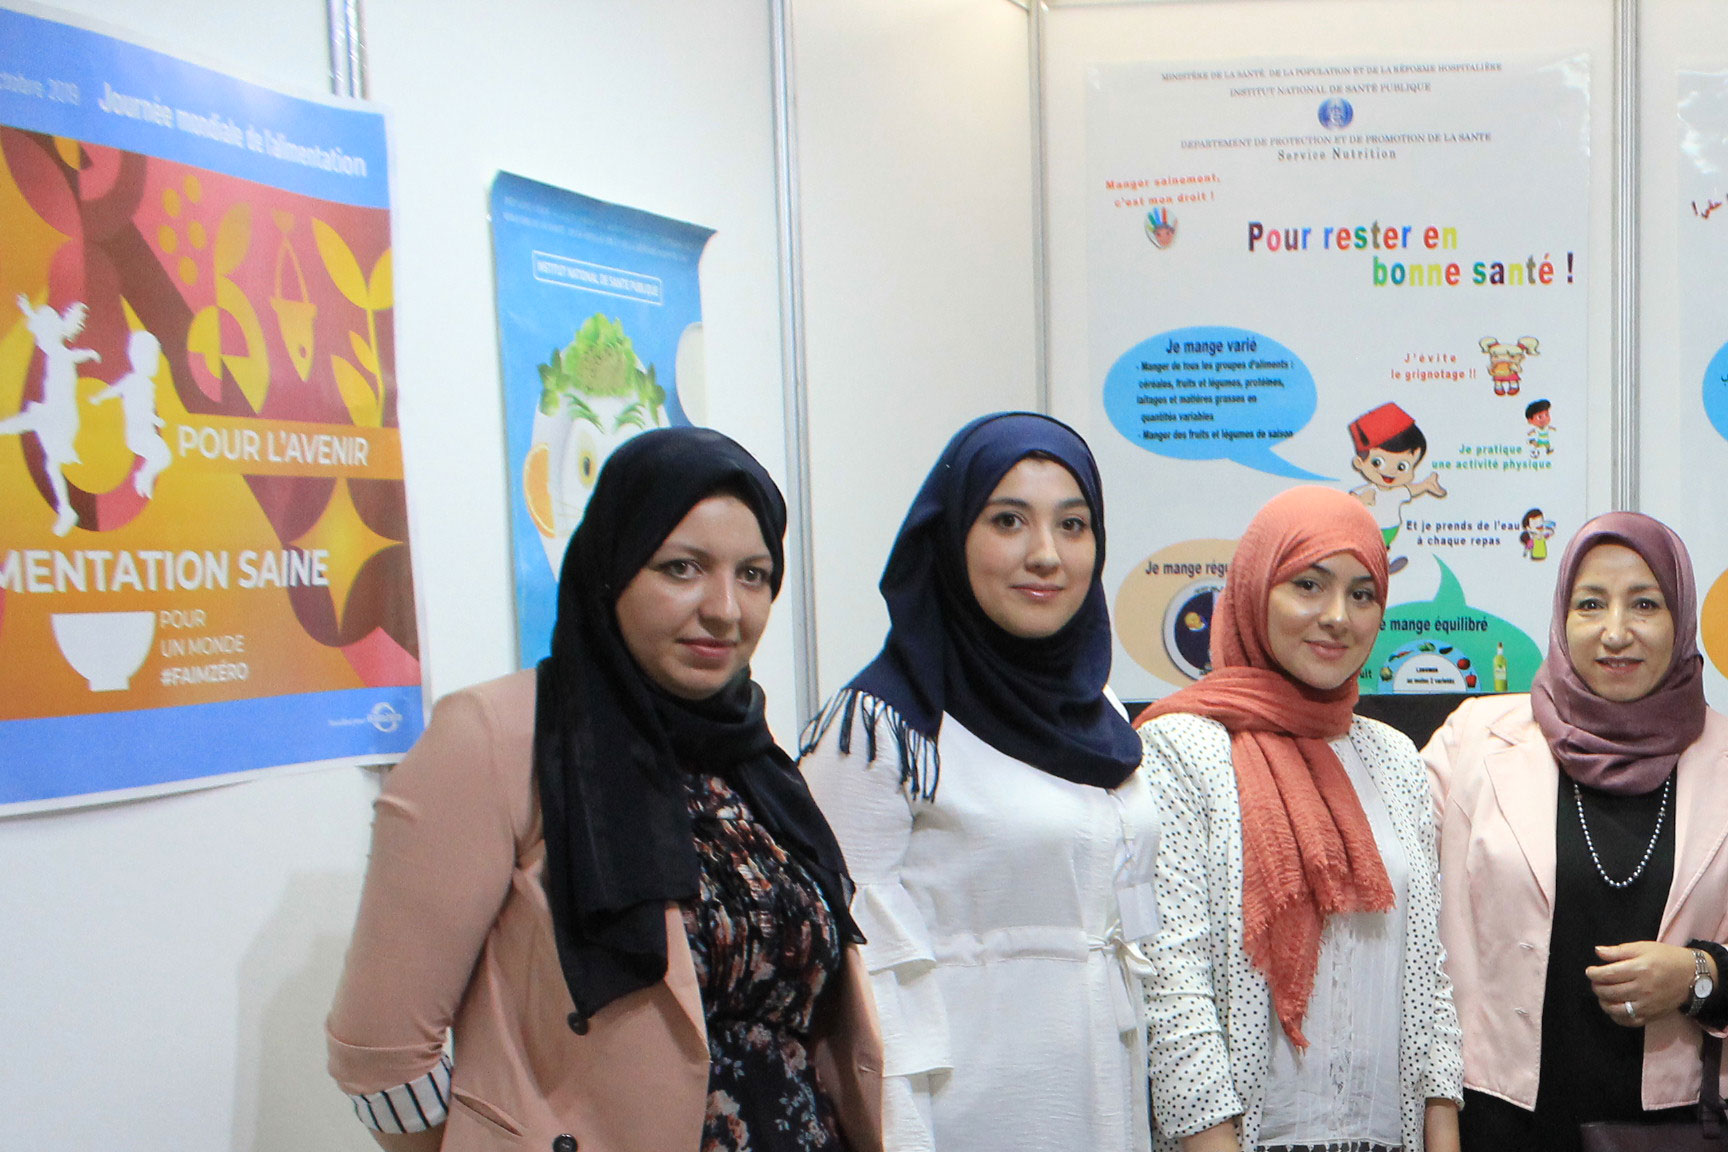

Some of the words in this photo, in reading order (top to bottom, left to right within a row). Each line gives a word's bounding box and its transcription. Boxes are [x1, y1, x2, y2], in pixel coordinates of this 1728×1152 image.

[1296, 65, 1350, 77] POPULATION
[1230, 87, 1275, 98] INSTITUT
[1277, 85, 1327, 96] NATIONAL
[1329, 85, 1343, 94] DE
[1380, 81, 1432, 94] PUBLIQUE
[98, 81, 175, 129] Journée
[175, 111, 244, 150] mondiale
[245, 123, 264, 154] de
[263, 127, 367, 178] l'alimentation
[1180, 138, 1251, 150] DEPARTEMENT
[1254, 137, 1267, 147] DE
[1270, 135, 1331, 147] PROTECTION
[1334, 135, 1346, 145] ET
[1350, 134, 1363, 145] DE
[1365, 133, 1425, 144] PROMOTION
[1427, 133, 1442, 143] DE
[1444, 133, 1457, 142] LA
[1278, 149, 1327, 161] Service
[1332, 147, 1397, 160] Nutrition
[1105, 179, 1149, 191] Manger
[1154, 173, 1220, 187] sainement,
[1114, 196, 1145, 208] c'est
[1148, 196, 1173, 206] mon
[1177, 191, 1207, 203] droit
[1248, 221, 1312, 252] Pour
[1323, 219, 1412, 251] rester
[1423, 226, 1457, 250] en
[1372, 255, 1461, 287] bonne
[1472, 252, 1554, 285] santé
[1566, 252, 1574, 285] !
[1166, 338, 1180, 354] Je
[1184, 341, 1224, 356] mange
[1228, 337, 1257, 352] varié
[1404, 352, 1457, 364] J'évite
[1391, 368, 1400, 379] le
[1405, 368, 1465, 382] grignotage
[1143, 430, 1171, 442] Manger
[1173, 429, 1187, 439] des
[1188, 429, 1210, 439] fruits
[1211, 429, 1220, 439] et
[1221, 429, 1254, 441] légumes
[1257, 429, 1266, 439] de
[1268, 429, 1294, 439] saison
[178, 425, 260, 460] POUR
[267, 431, 370, 467] L'AVENIR
[1459, 444, 1473, 455] Je
[1476, 444, 1523, 457] pratique
[1431, 459, 1451, 469] une
[1455, 458, 1499, 470] activité
[1502, 458, 1552, 473] physique
[1406, 520, 1417, 531] Et
[1421, 520, 1432, 532] je
[1435, 520, 1473, 532] prends
[1477, 520, 1490, 531] de
[1493, 520, 1520, 531] l'eau
[1417, 535, 1423, 545] à
[1428, 535, 1467, 547] chaque
[1471, 536, 1501, 547] repas
[237, 549, 331, 590] SAINE
[1145, 560, 1160, 575] Je
[1163, 562, 1202, 578] mange
[160, 608, 207, 630] POUR
[1390, 621, 1431, 635] mange
[1434, 615, 1488, 635] équilibré
[161, 637, 187, 658] UN
[188, 635, 246, 657] MONDE
[160, 661, 250, 687] #FAIMZÉRO
